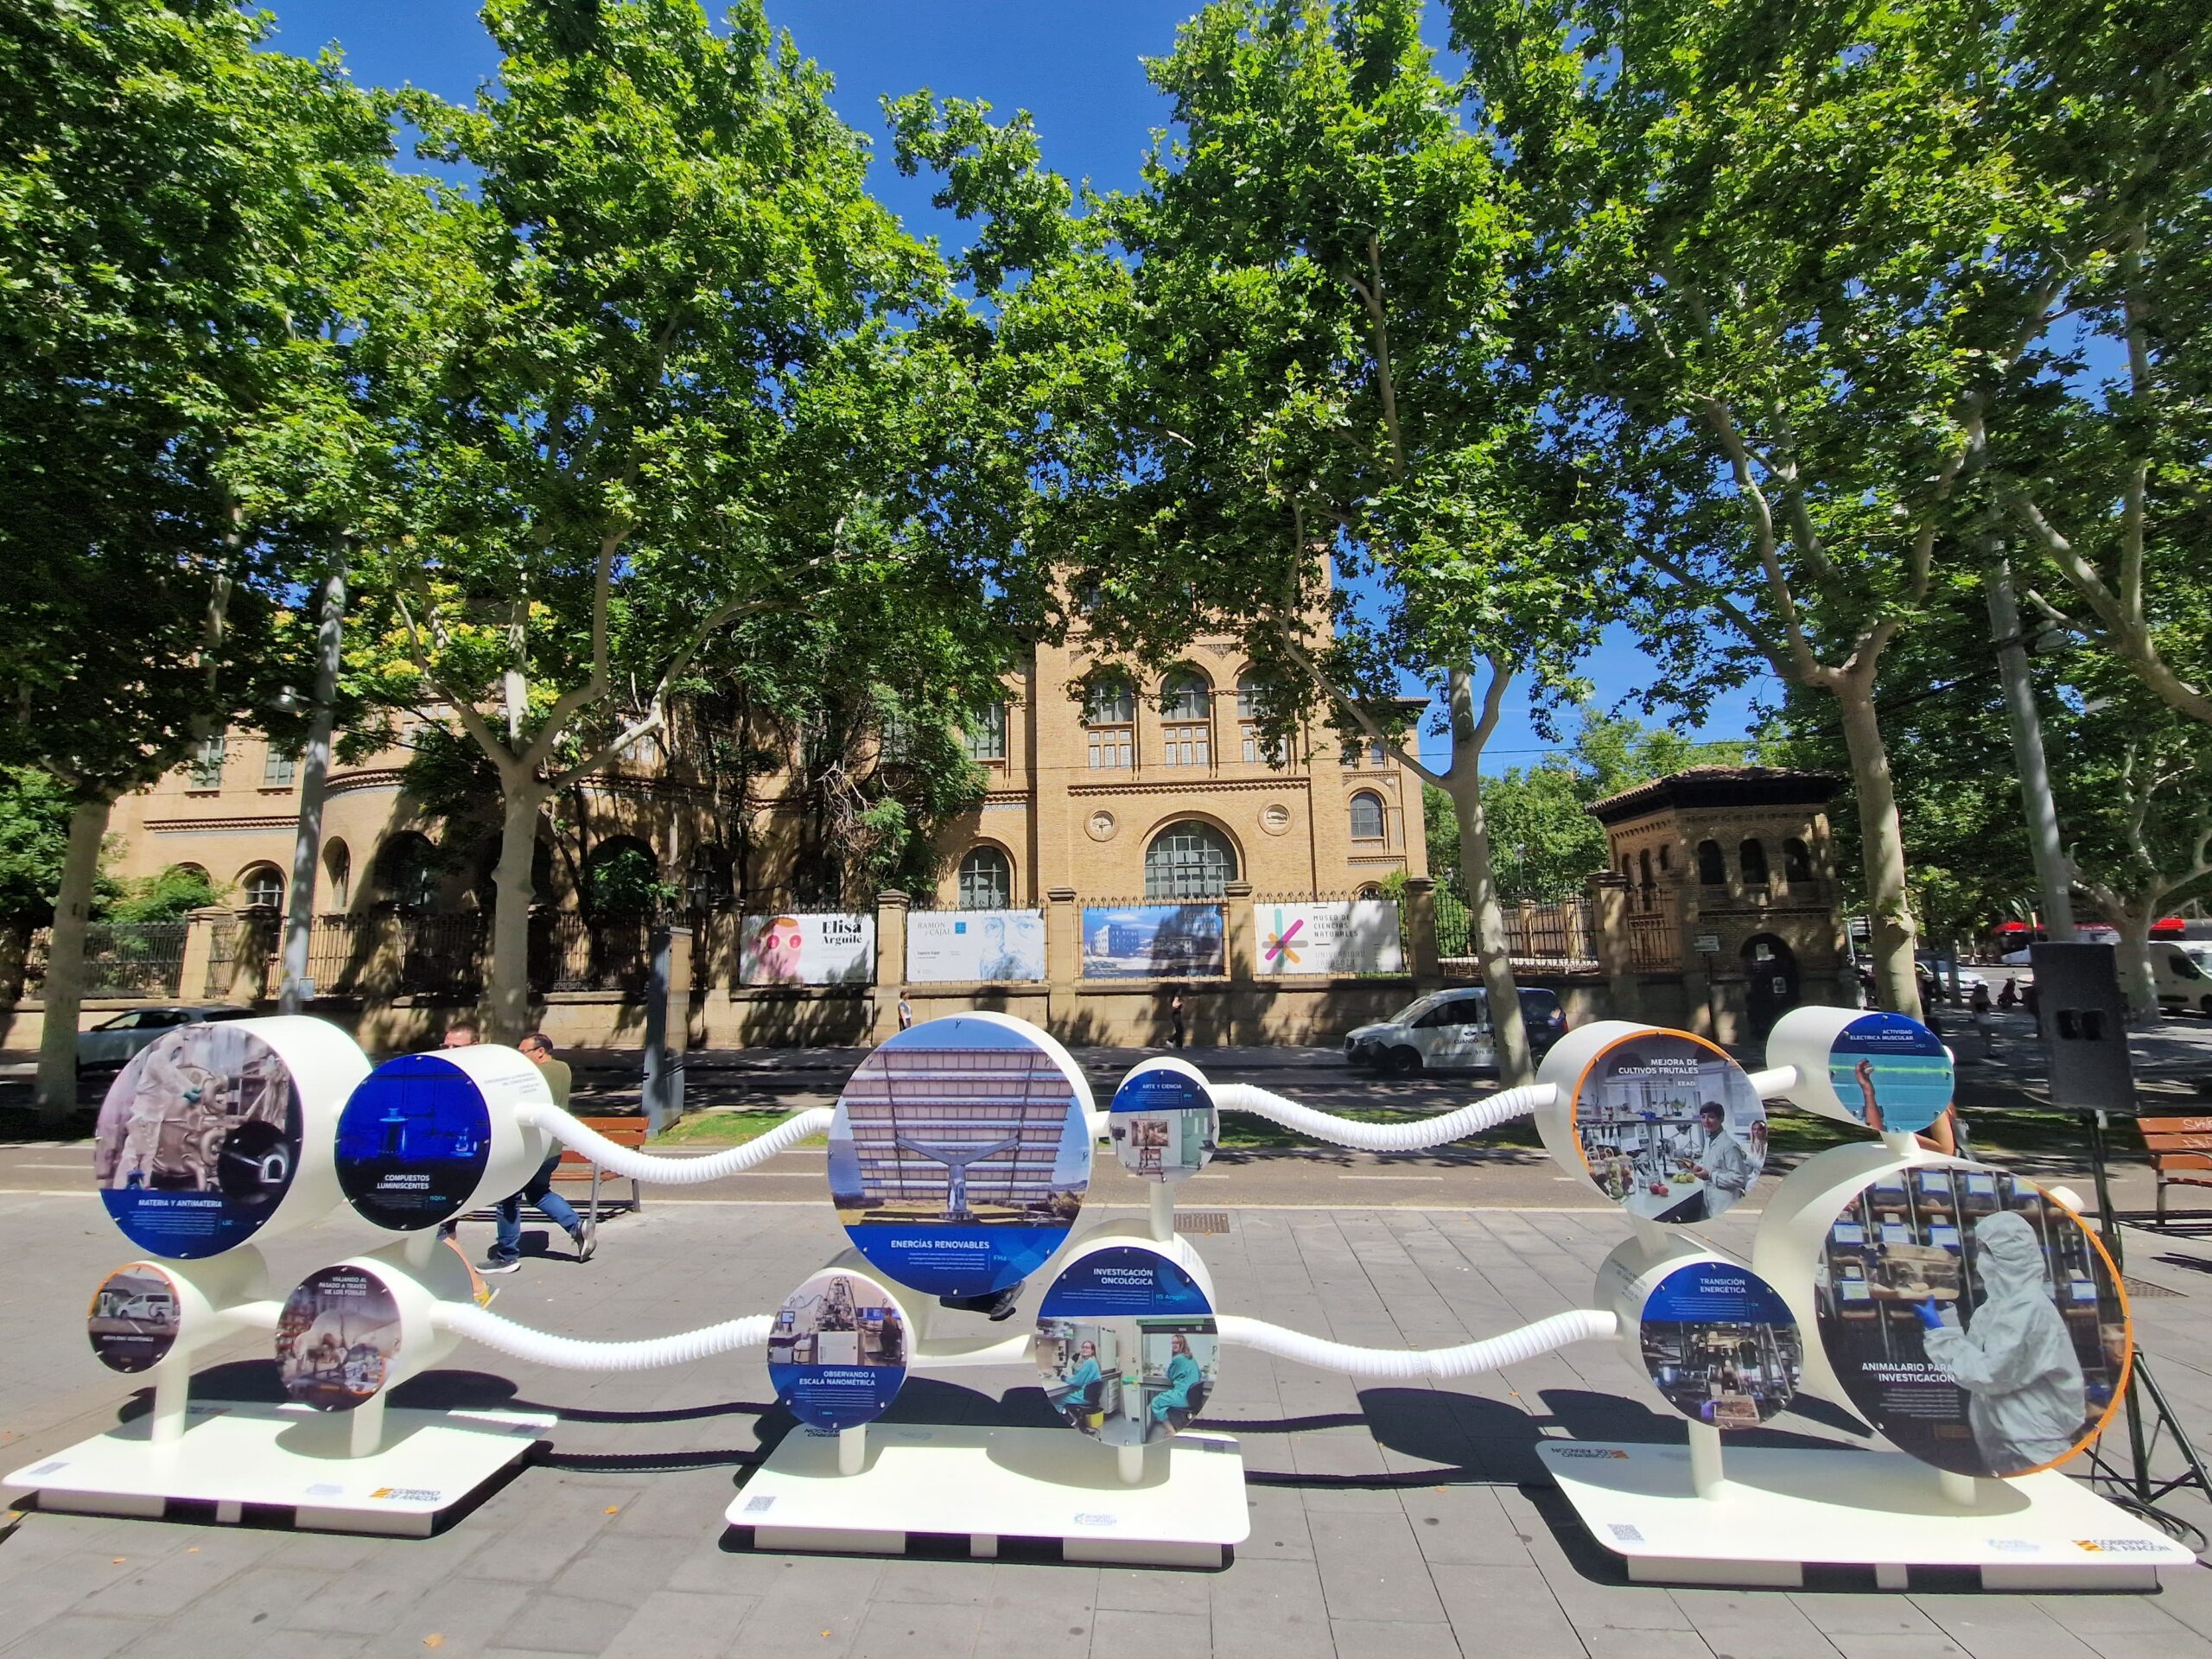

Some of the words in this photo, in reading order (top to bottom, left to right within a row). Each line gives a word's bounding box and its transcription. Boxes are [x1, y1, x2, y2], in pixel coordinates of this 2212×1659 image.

[822, 919, 861, 934] Elisa
[822, 934, 862, 946] Arguilé
[891, 1238, 932, 1248] ENERGÍAS
[1093, 1267, 1154, 1276] INVESTIGACIÓN
[1101, 1276, 1154, 1285] ONCOLÓGICA
[1862, 1362, 1925, 1371] ANIMALARIO
[1927, 1363, 1954, 1372] PARA
[826, 1377, 875, 1386] NANOMÉTRICA
